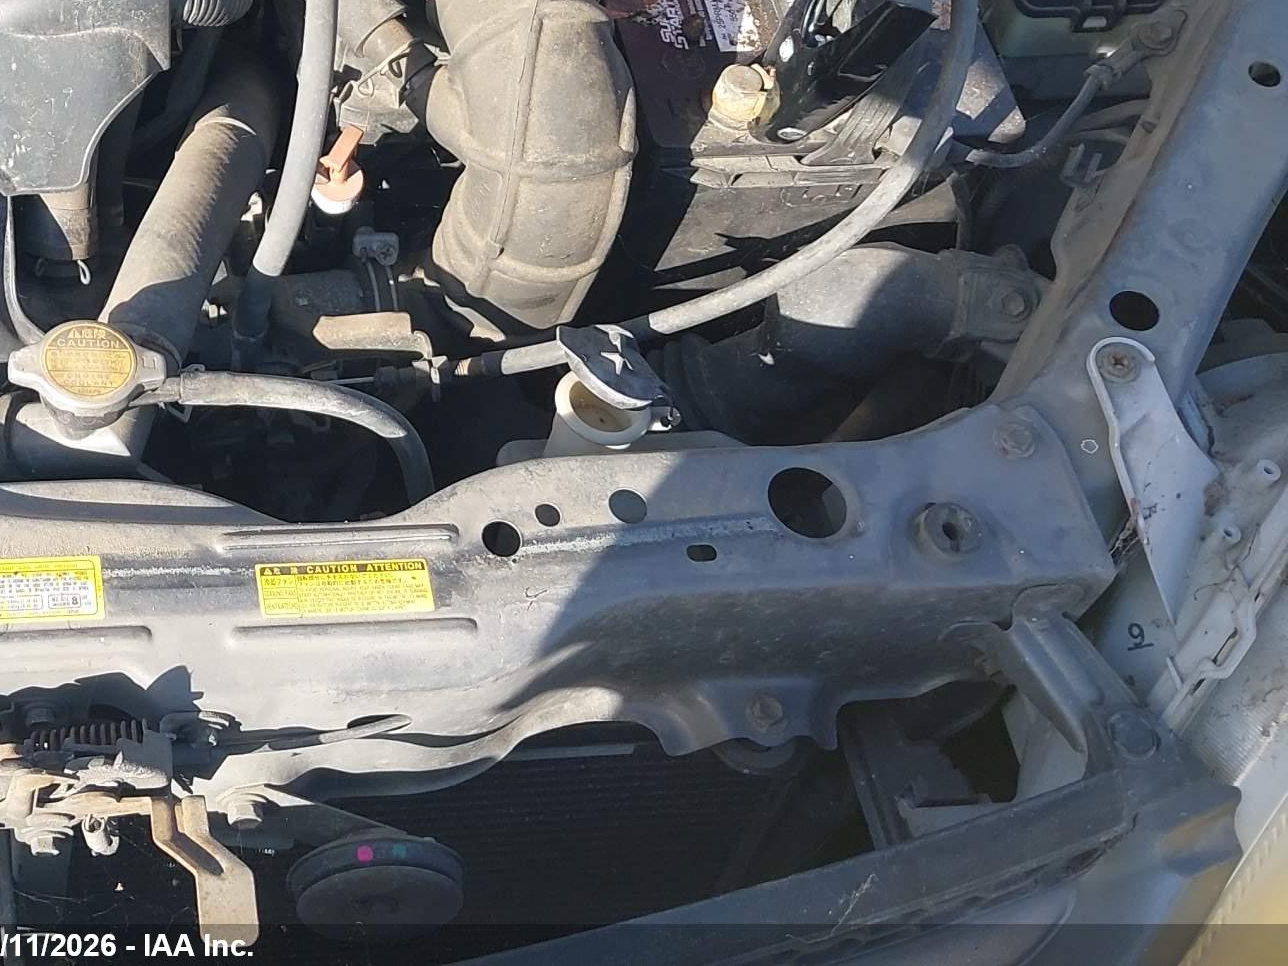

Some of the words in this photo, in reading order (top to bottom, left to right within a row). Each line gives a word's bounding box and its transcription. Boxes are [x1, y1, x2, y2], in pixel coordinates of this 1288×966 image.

[57, 338, 119, 348] CAUTION
[306, 564, 358, 574] CAUTION
[366, 562, 422, 572] ATTENTION
[72, 596, 79, 605] 8
